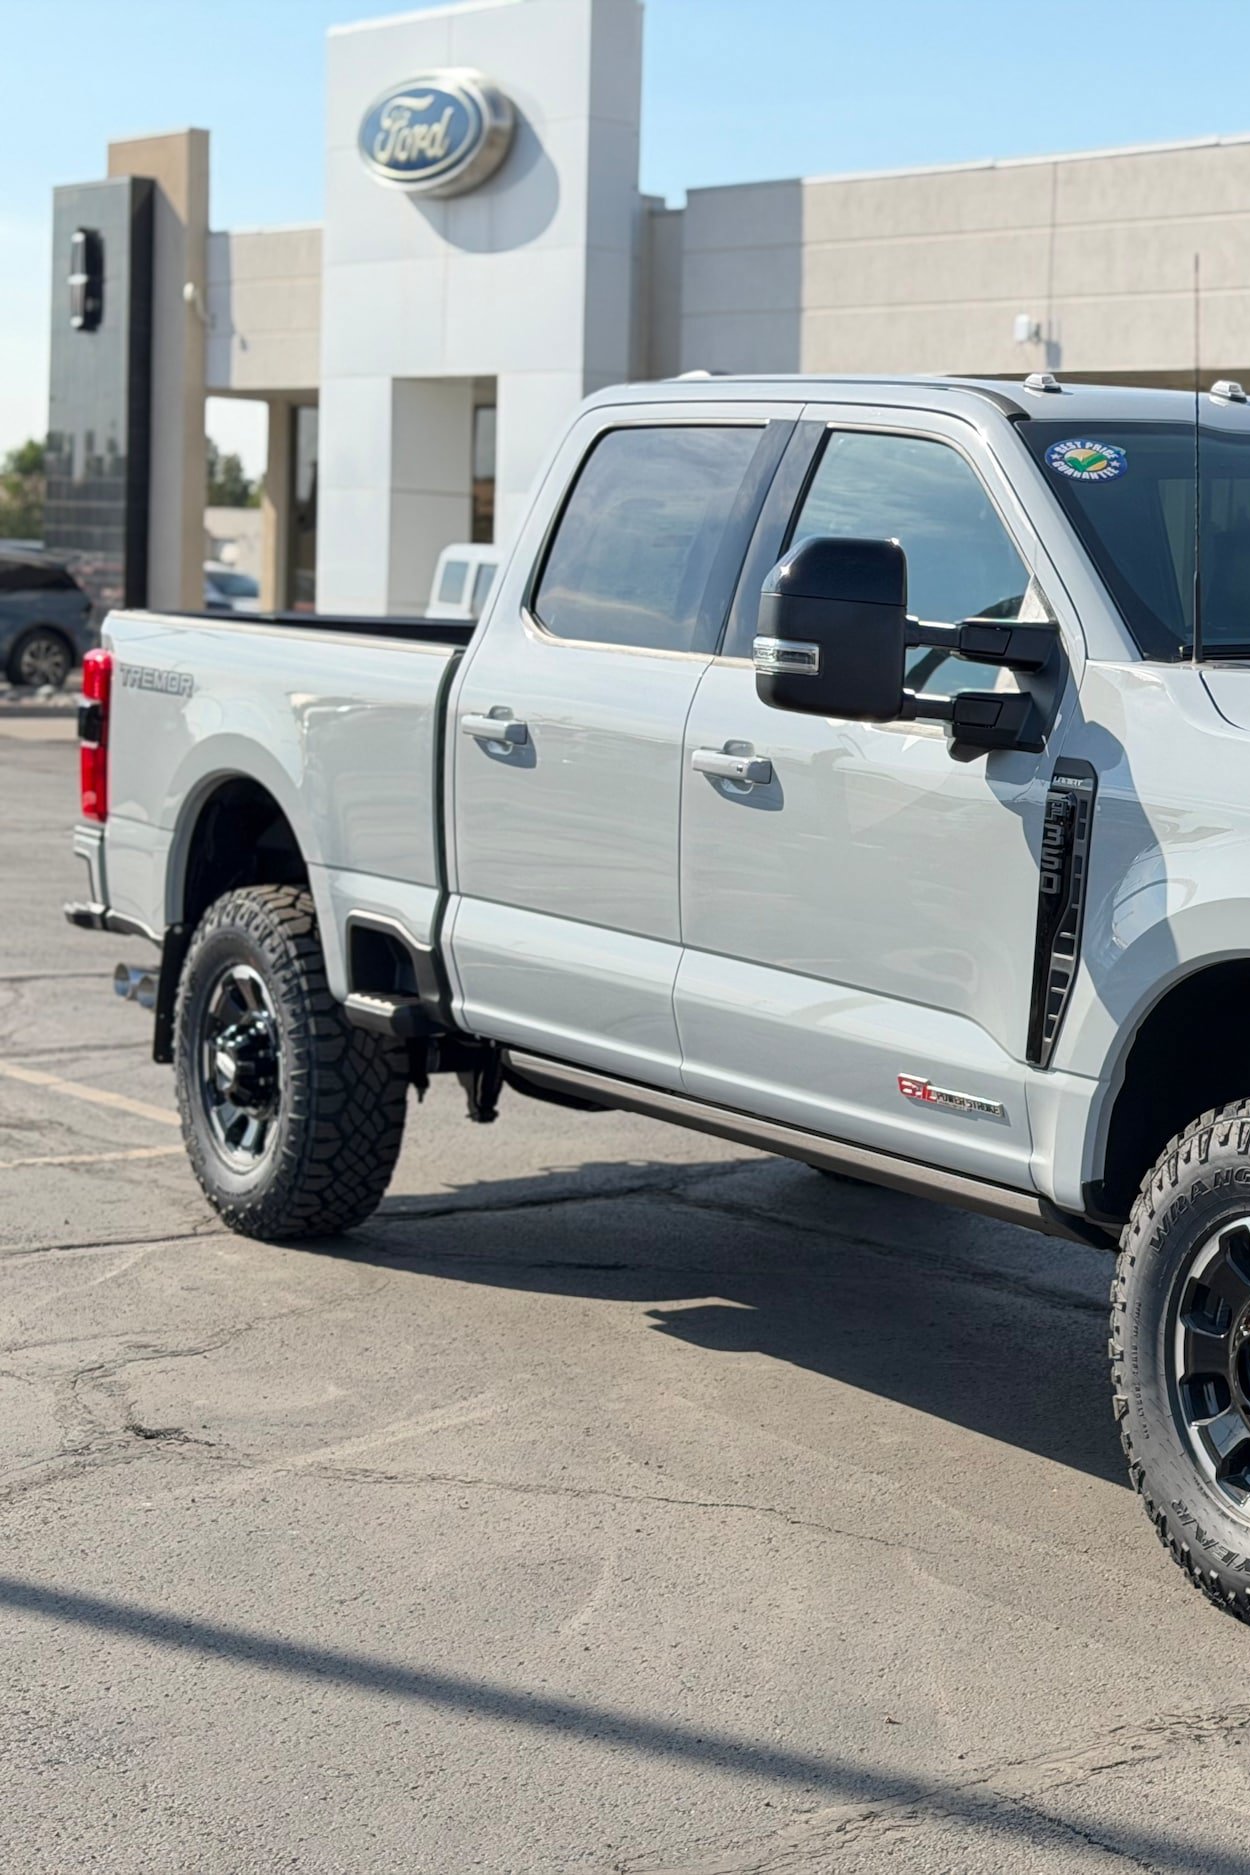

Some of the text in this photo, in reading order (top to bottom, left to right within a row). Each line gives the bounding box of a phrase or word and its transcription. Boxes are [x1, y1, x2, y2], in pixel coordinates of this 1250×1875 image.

[373, 95, 454, 164] Ford
[1053, 441, 1119, 459] BEST PRICE
[1052, 461, 1120, 480] GUARANTEE
[119, 662, 194, 699] TREMOR
